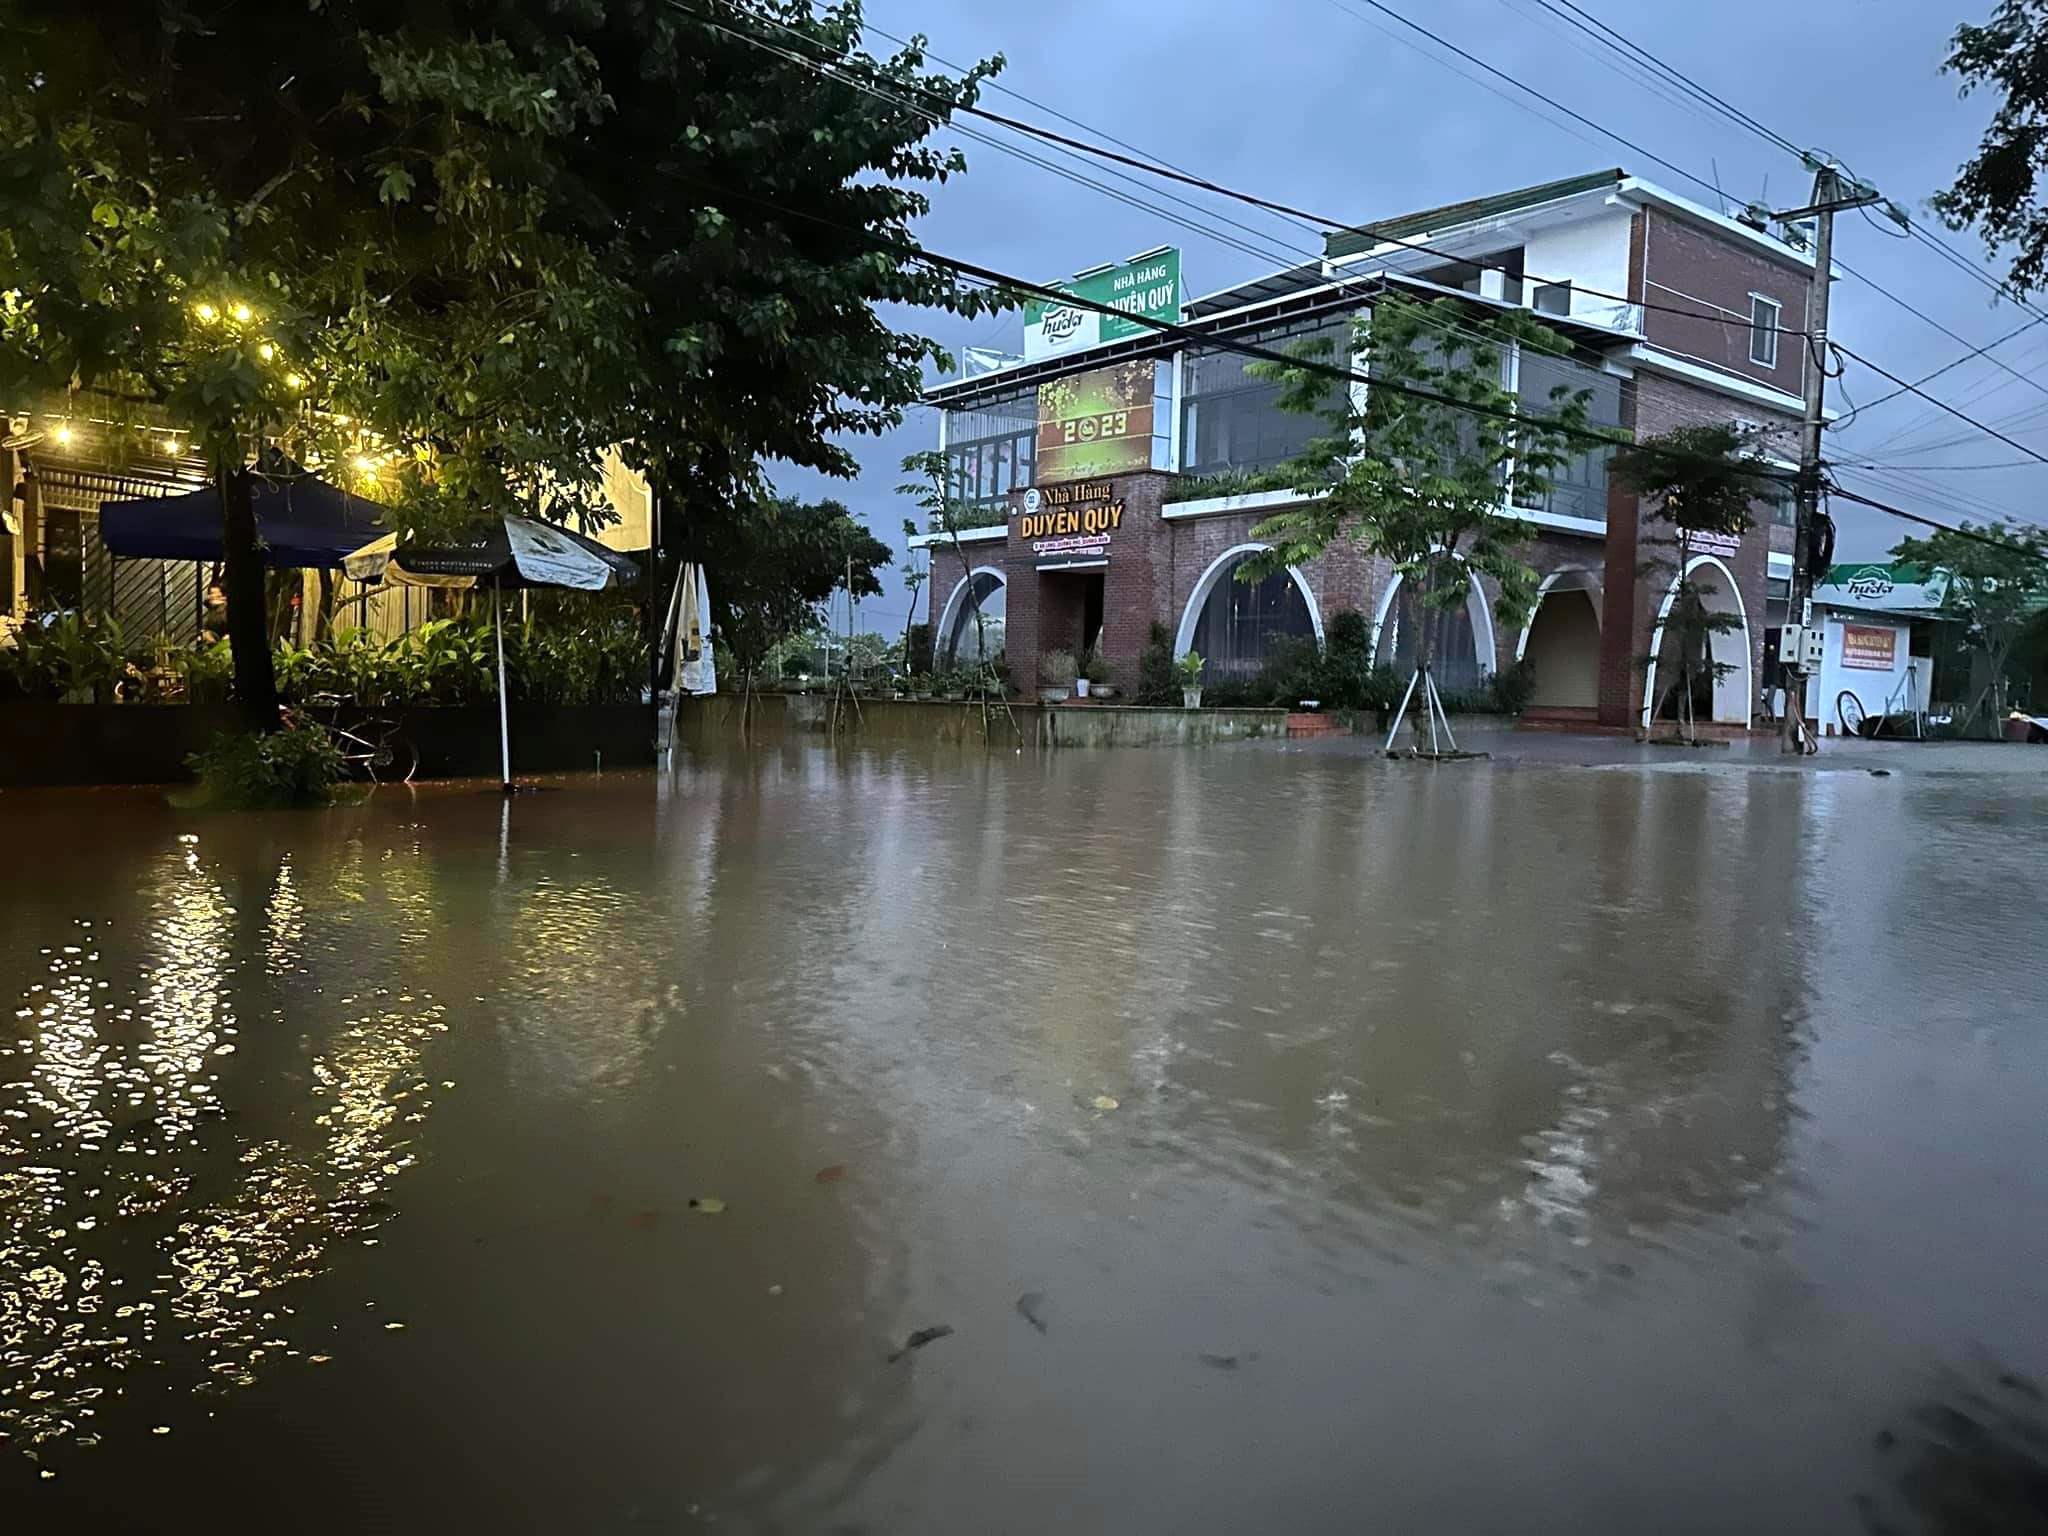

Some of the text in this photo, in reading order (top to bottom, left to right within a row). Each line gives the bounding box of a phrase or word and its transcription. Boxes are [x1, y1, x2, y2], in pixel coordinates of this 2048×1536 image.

[1113, 264, 1167, 292] NHÀ HÀNG
[1148, 280, 1175, 311] QUÝ
[1044, 483, 1111, 506] Nhà Hàng
[1022, 499, 1124, 538] DUYÊN QUÝ
